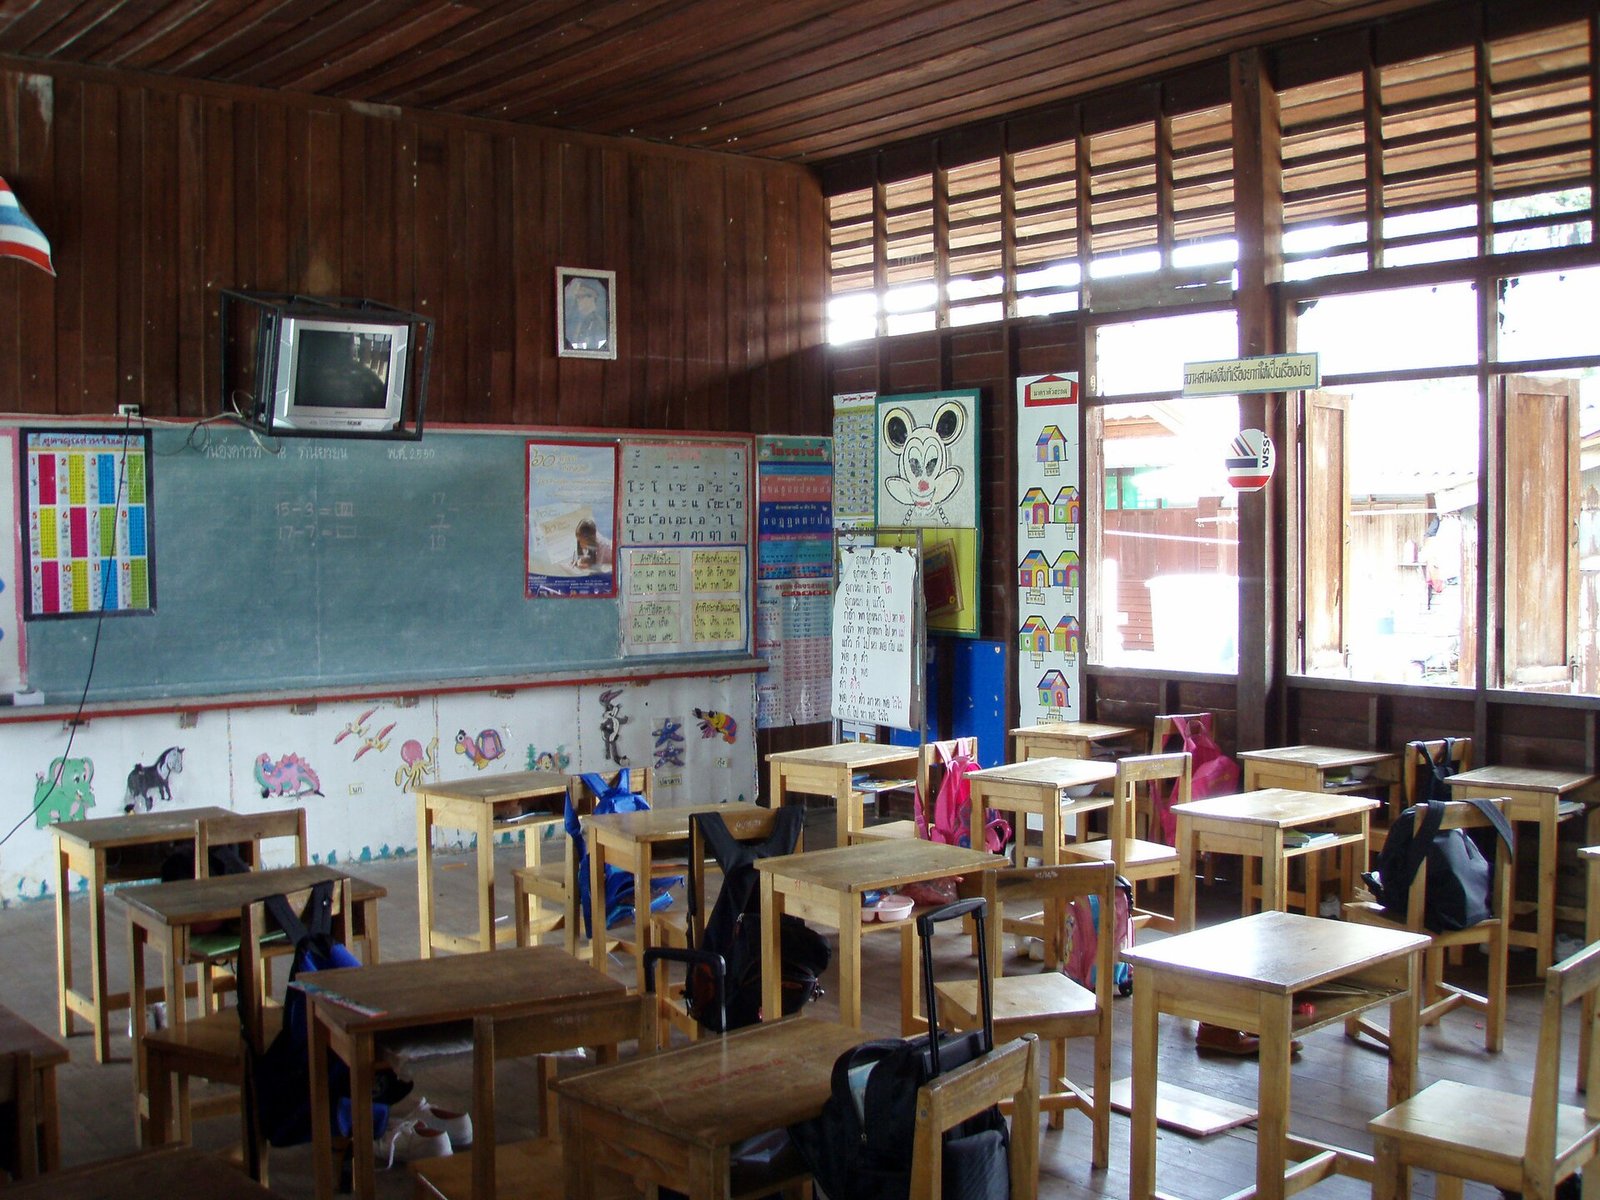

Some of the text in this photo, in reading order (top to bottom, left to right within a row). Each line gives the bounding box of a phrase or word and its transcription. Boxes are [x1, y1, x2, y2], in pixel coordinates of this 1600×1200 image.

[1261, 432, 1270, 468] WSS
[61, 457, 67, 466] 2
[91, 457, 97, 466] 3
[32, 511, 38, 520] 5
[62, 511, 68, 519] 6
[122, 510, 127, 518] 8
[34, 565, 40, 573] 9
[62, 564, 72, 573] 10
[122, 562, 130, 571] 12
